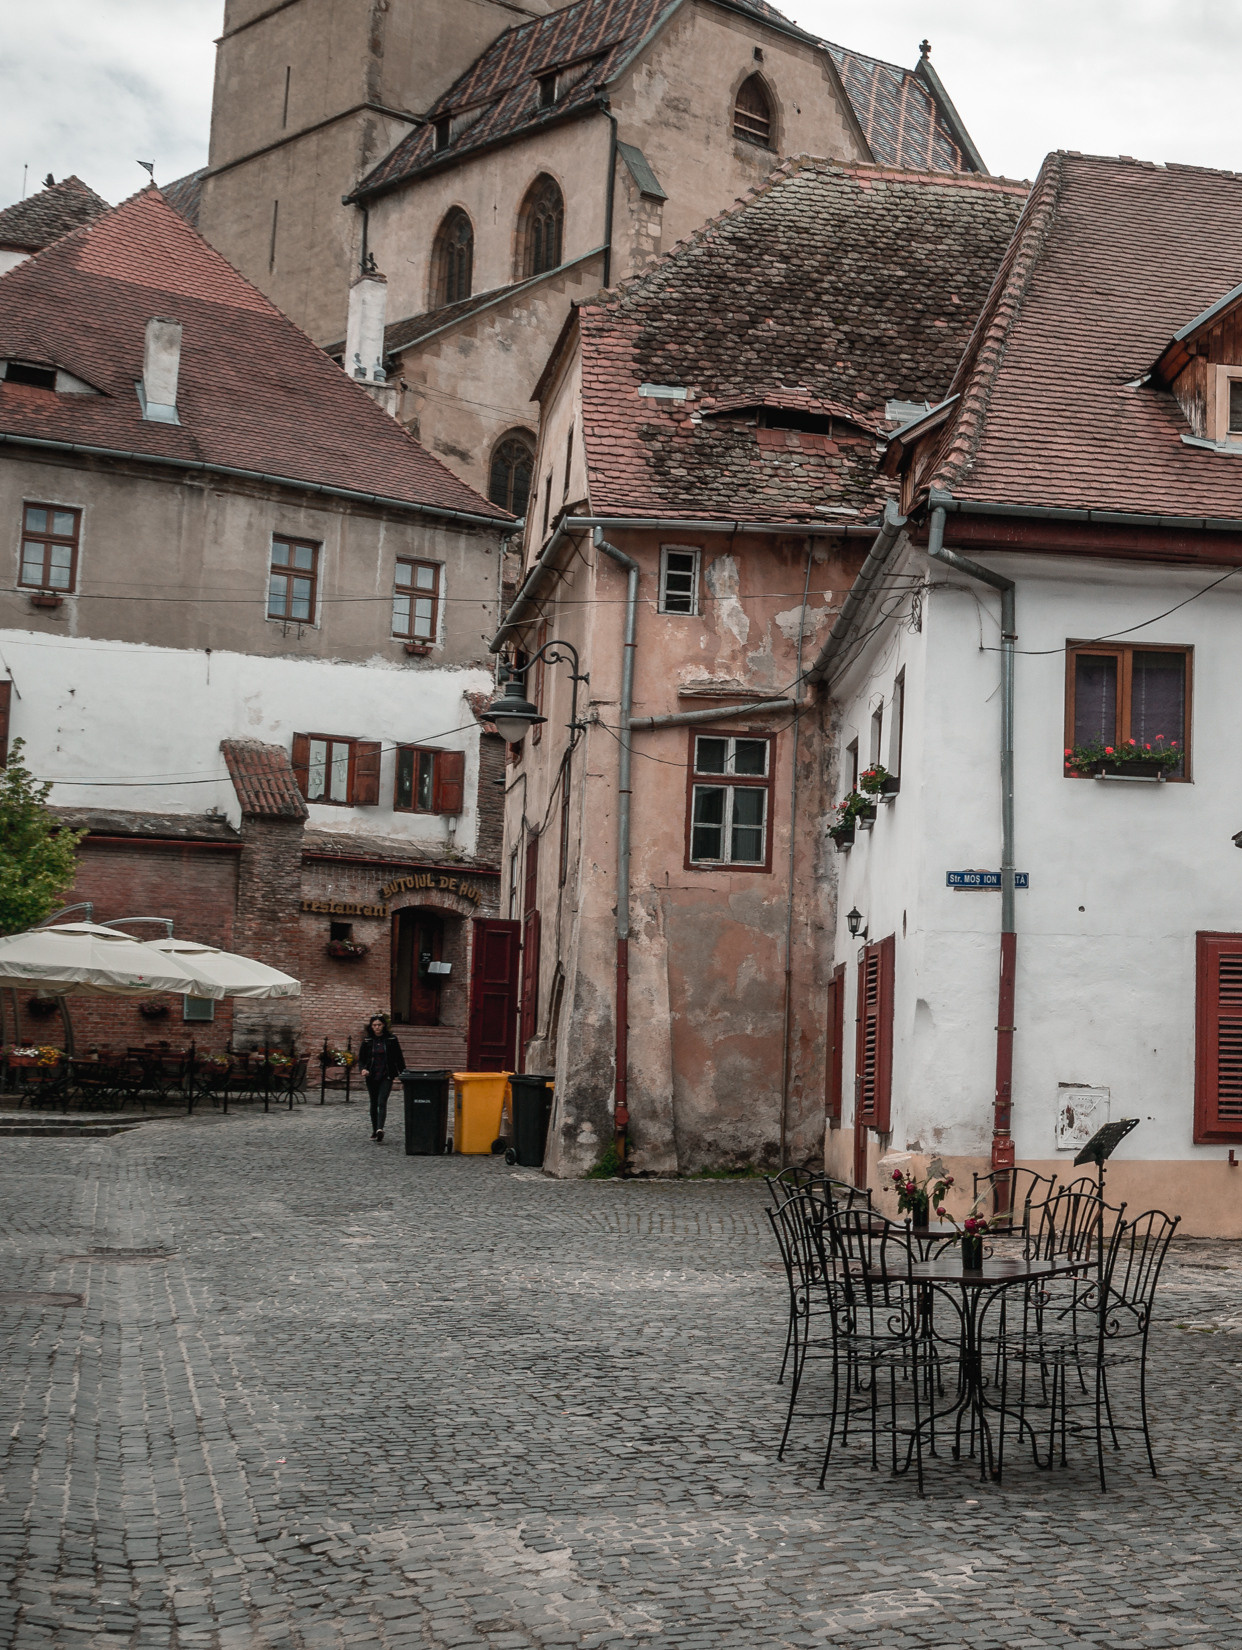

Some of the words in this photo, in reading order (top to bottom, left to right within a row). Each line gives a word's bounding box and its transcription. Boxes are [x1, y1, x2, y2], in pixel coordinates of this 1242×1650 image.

[439, 876, 458, 890] DE
[949, 874, 962, 883] Str.
[983, 875, 997, 883] ION
[302, 898, 390, 917] restaurant
